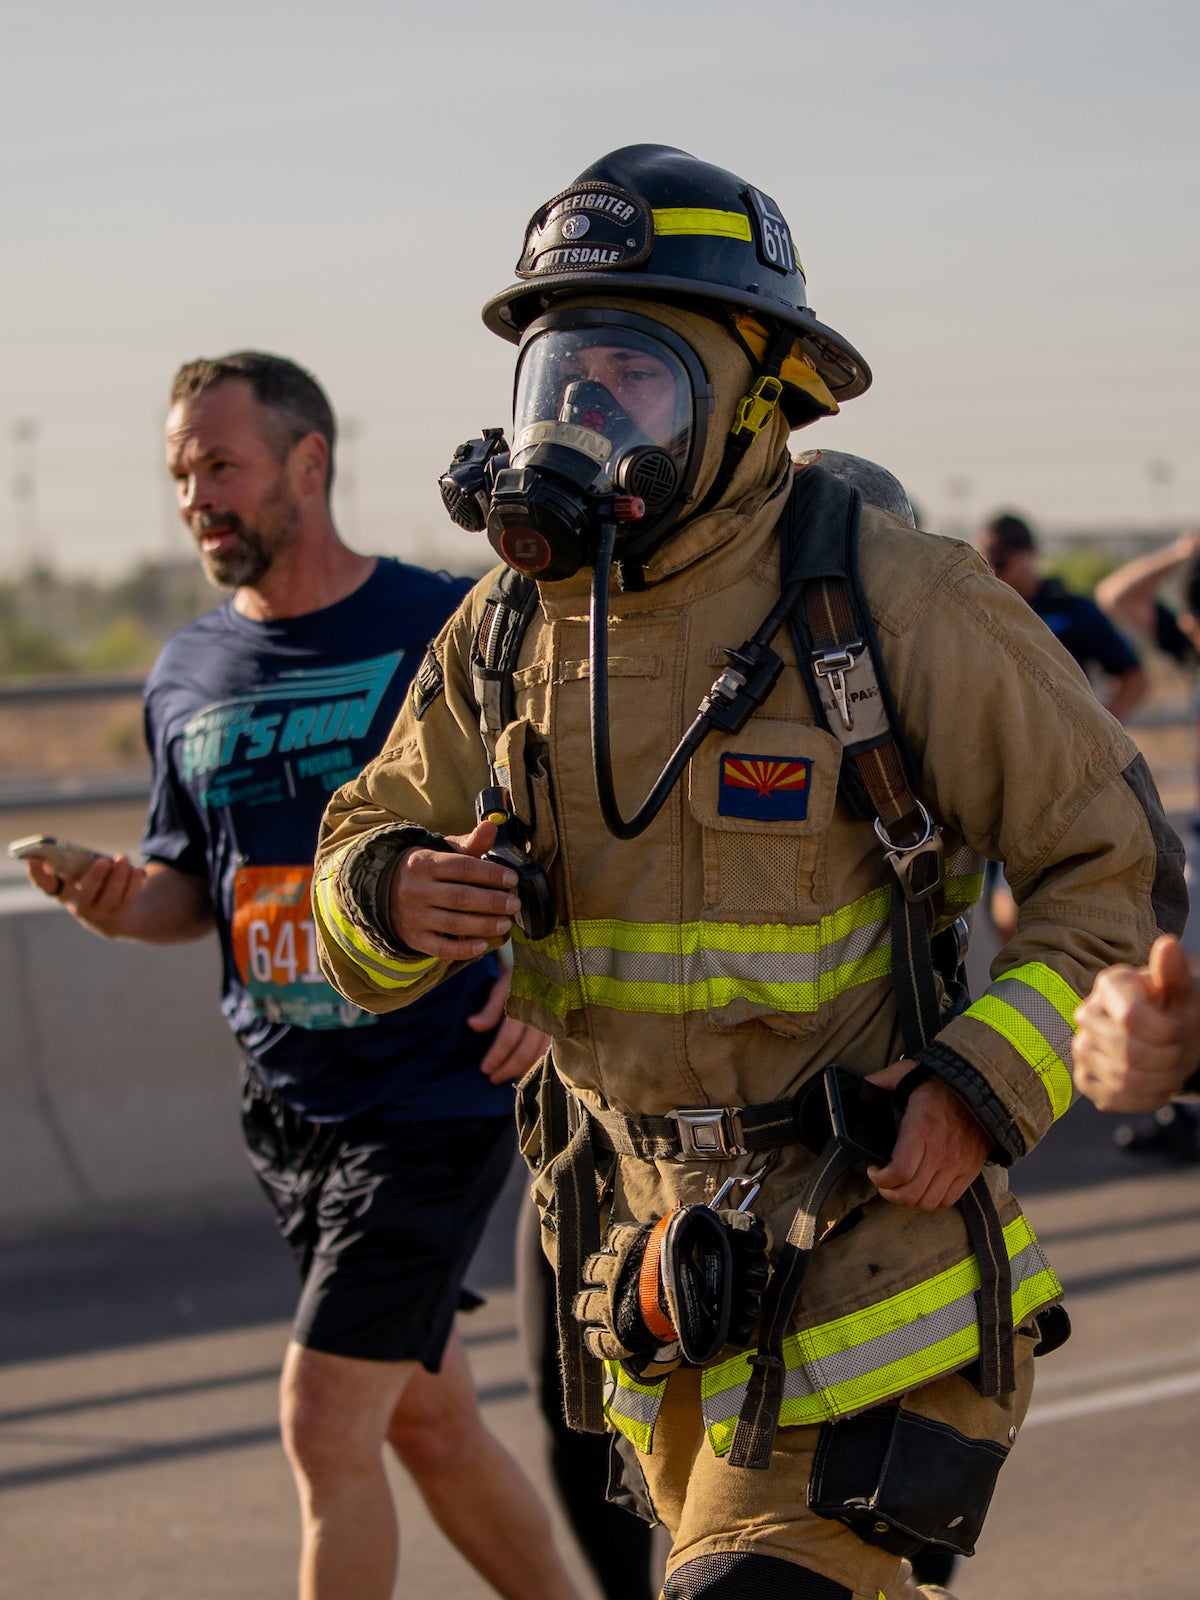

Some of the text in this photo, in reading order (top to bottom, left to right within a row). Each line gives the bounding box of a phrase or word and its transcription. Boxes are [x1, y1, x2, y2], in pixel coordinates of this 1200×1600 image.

[551, 193, 635, 221] EFIGHTER
[537, 247, 620, 265] OTTSDALE
[763, 218, 793, 270] 611
[278, 698, 372, 753] RUN
[247, 919, 327, 984] 641
